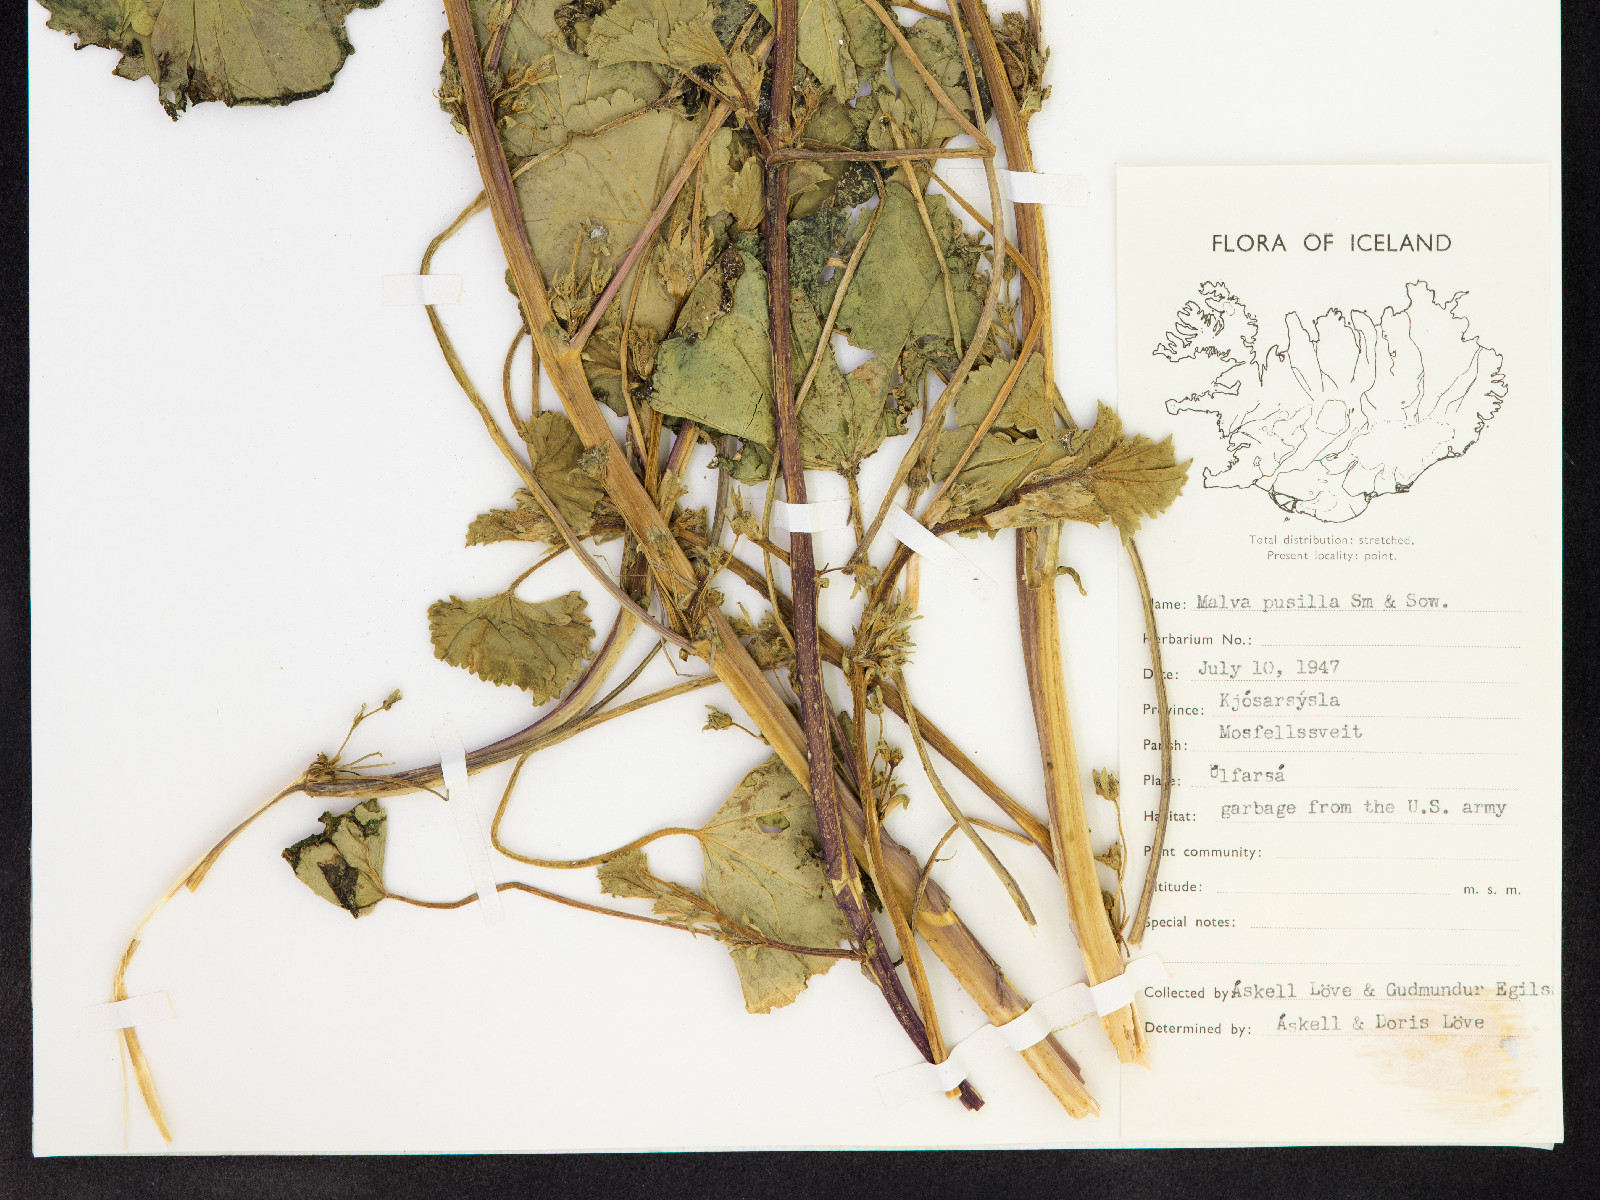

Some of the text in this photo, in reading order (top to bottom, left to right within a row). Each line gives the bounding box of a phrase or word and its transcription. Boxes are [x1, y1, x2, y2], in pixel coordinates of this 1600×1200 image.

[1213, 233, 1451, 252] FLORA OF ICELAND
[1249, 535, 1415, 545] Total distribution: stretched.
[1267, 550, 1397, 562] Present locality: point.
[1152, 593, 1447, 612] ame: Malva pusilla Sm & Sow.
[1143, 633, 1251, 645] Hrbarium No.:
[1199, 661, 1241, 679] July
[1253, 661, 1282, 678] 10,
[1297, 660, 1339, 674] 1947
[1143, 690, 1340, 716] Prvince: Kjósarsýsla
[1143, 724, 1362, 751] Parsh: Mosfellssveit
[1143, 774, 1181, 786] Plae:
[1143, 800, 1507, 822] Haitat: garbage from the U.S. army
[1144, 846, 1262, 861] Pnt community:
[1154, 881, 1520, 895] ltitude: m. s. m.
[1196, 918, 1235, 927] notes:
[1144, 987, 1204, 998] Collected
[1310, 982, 1351, 997] Löve
[1364, 984, 1375, 996] &
[1387, 982, 1483, 996] Gudmundur
[1496, 981, 1554, 1000] Egils
[1145, 1013, 1484, 1037] Determined by: Áskell & Doris Löve
